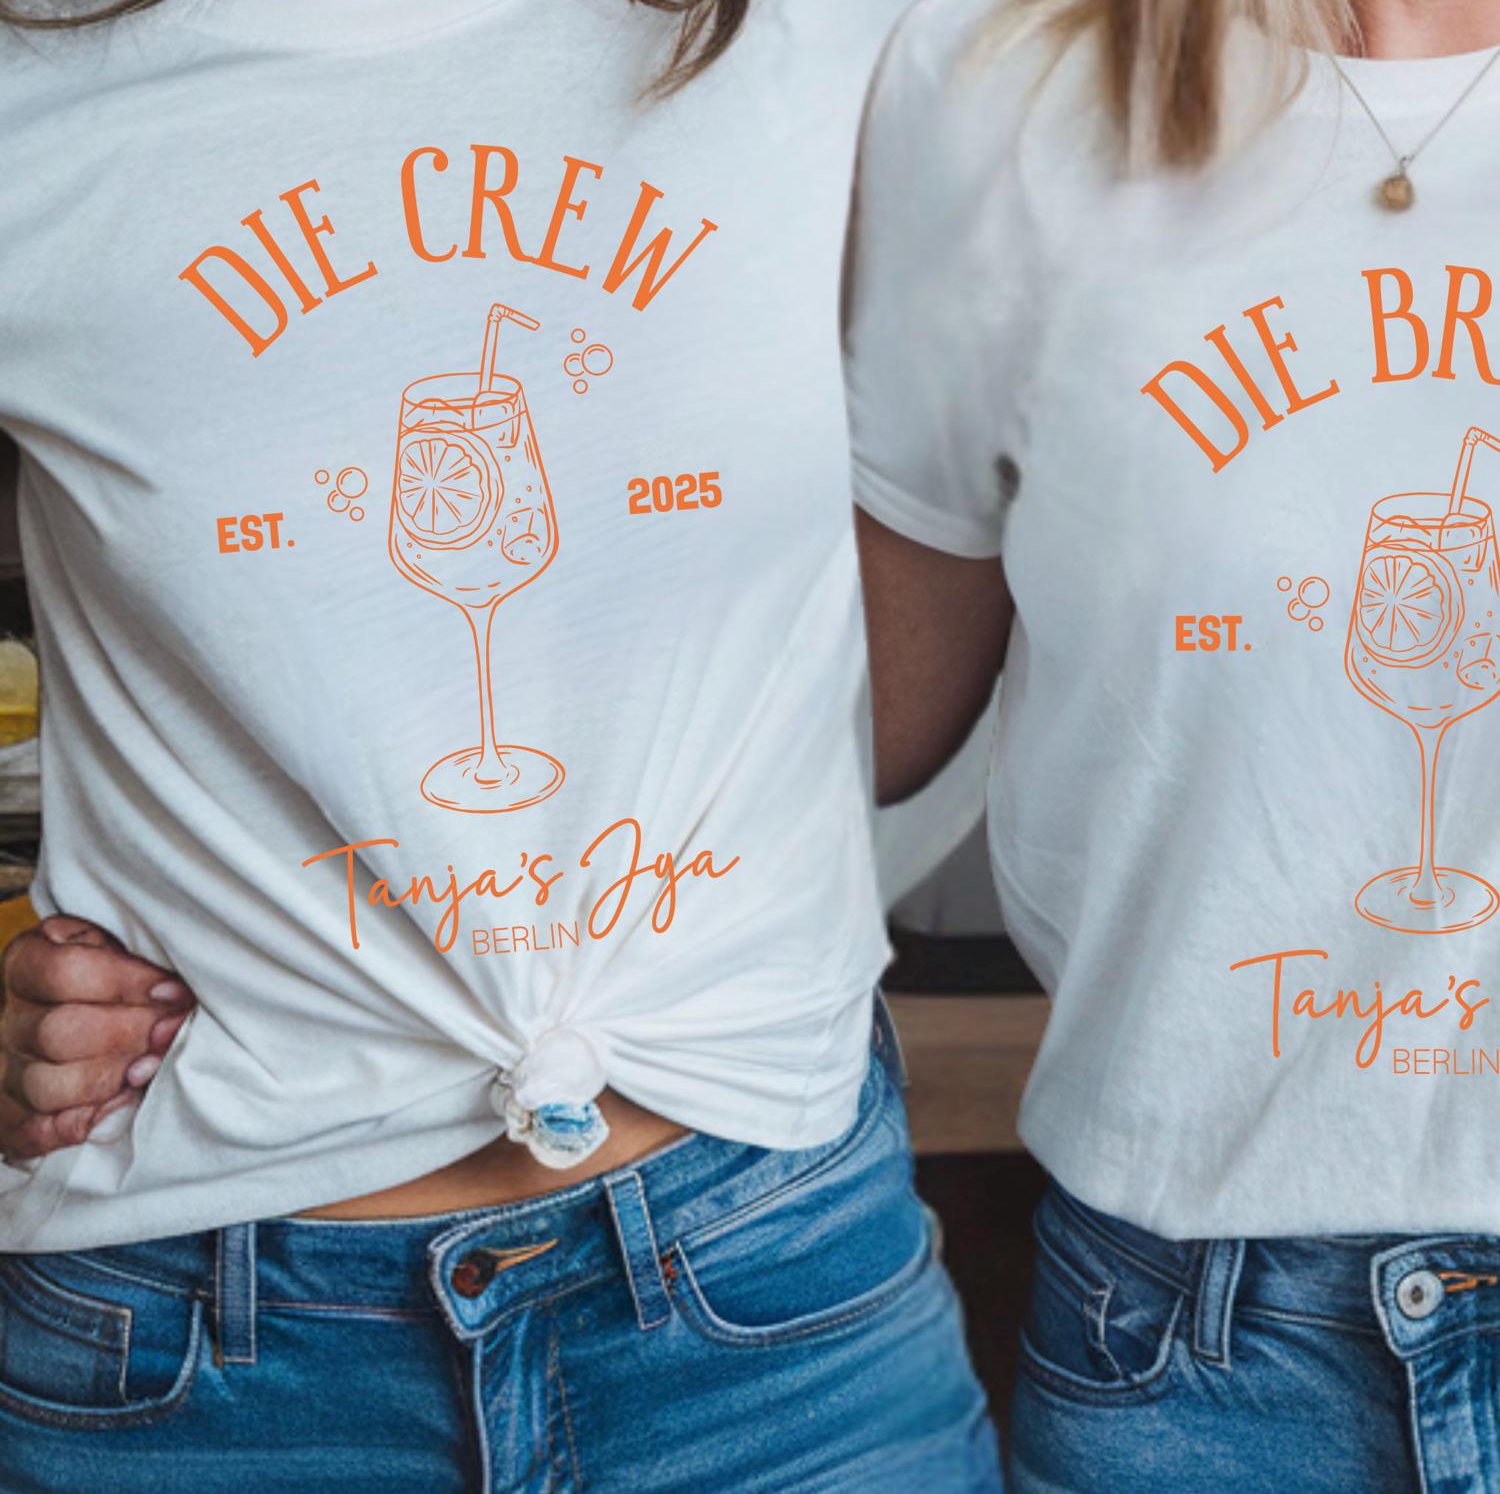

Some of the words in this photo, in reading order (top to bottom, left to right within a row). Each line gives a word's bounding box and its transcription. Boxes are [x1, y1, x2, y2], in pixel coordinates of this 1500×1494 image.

[178, 180, 378, 357] DIE
[401, 144, 718, 312] CREW
[1140, 296, 1340, 474] DIE
[216, 513, 295, 554] EST.
[627, 472, 722, 515] 2025
[1175, 615, 1252, 652] EST.
[472, 921, 580, 956] BERLIN
[1393, 1049, 1499, 1075] BERLIN
